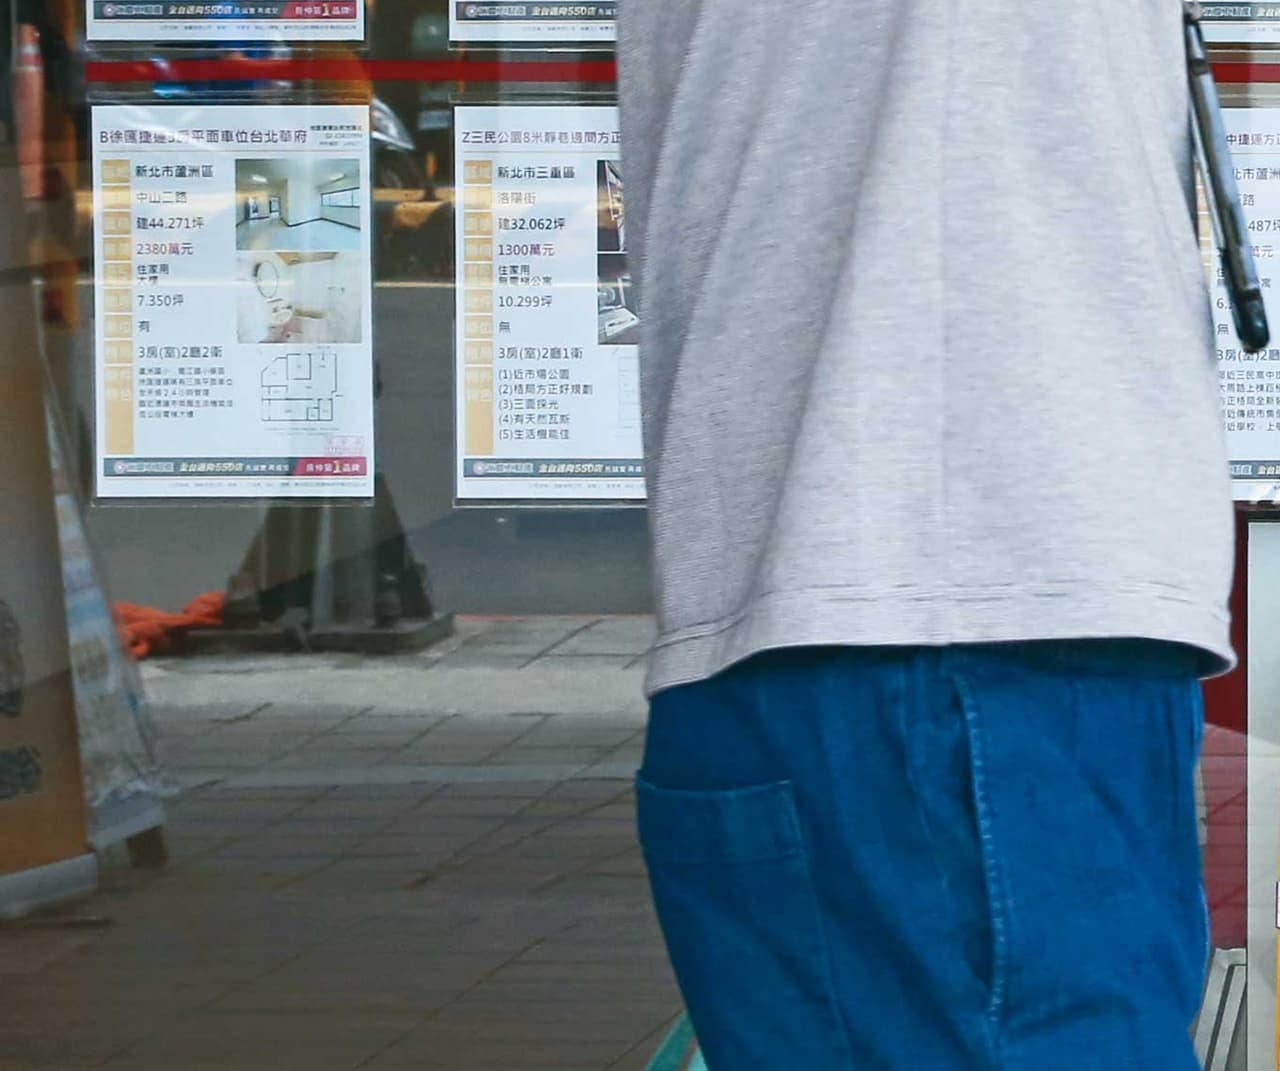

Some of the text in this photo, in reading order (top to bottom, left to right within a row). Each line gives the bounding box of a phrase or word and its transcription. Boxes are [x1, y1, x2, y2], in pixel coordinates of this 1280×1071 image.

[136, 165, 213, 178] 新北市蘆洲區
[498, 167, 575, 179] 新北市三重區
[137, 217, 204, 230] 建44.271坪
[499, 218, 565, 230] 建32.062坪
[136, 243, 194, 256] 2380萬元
[499, 244, 555, 256] 1300萬元
[499, 347, 583, 359] 3房(室)2廳1衛
